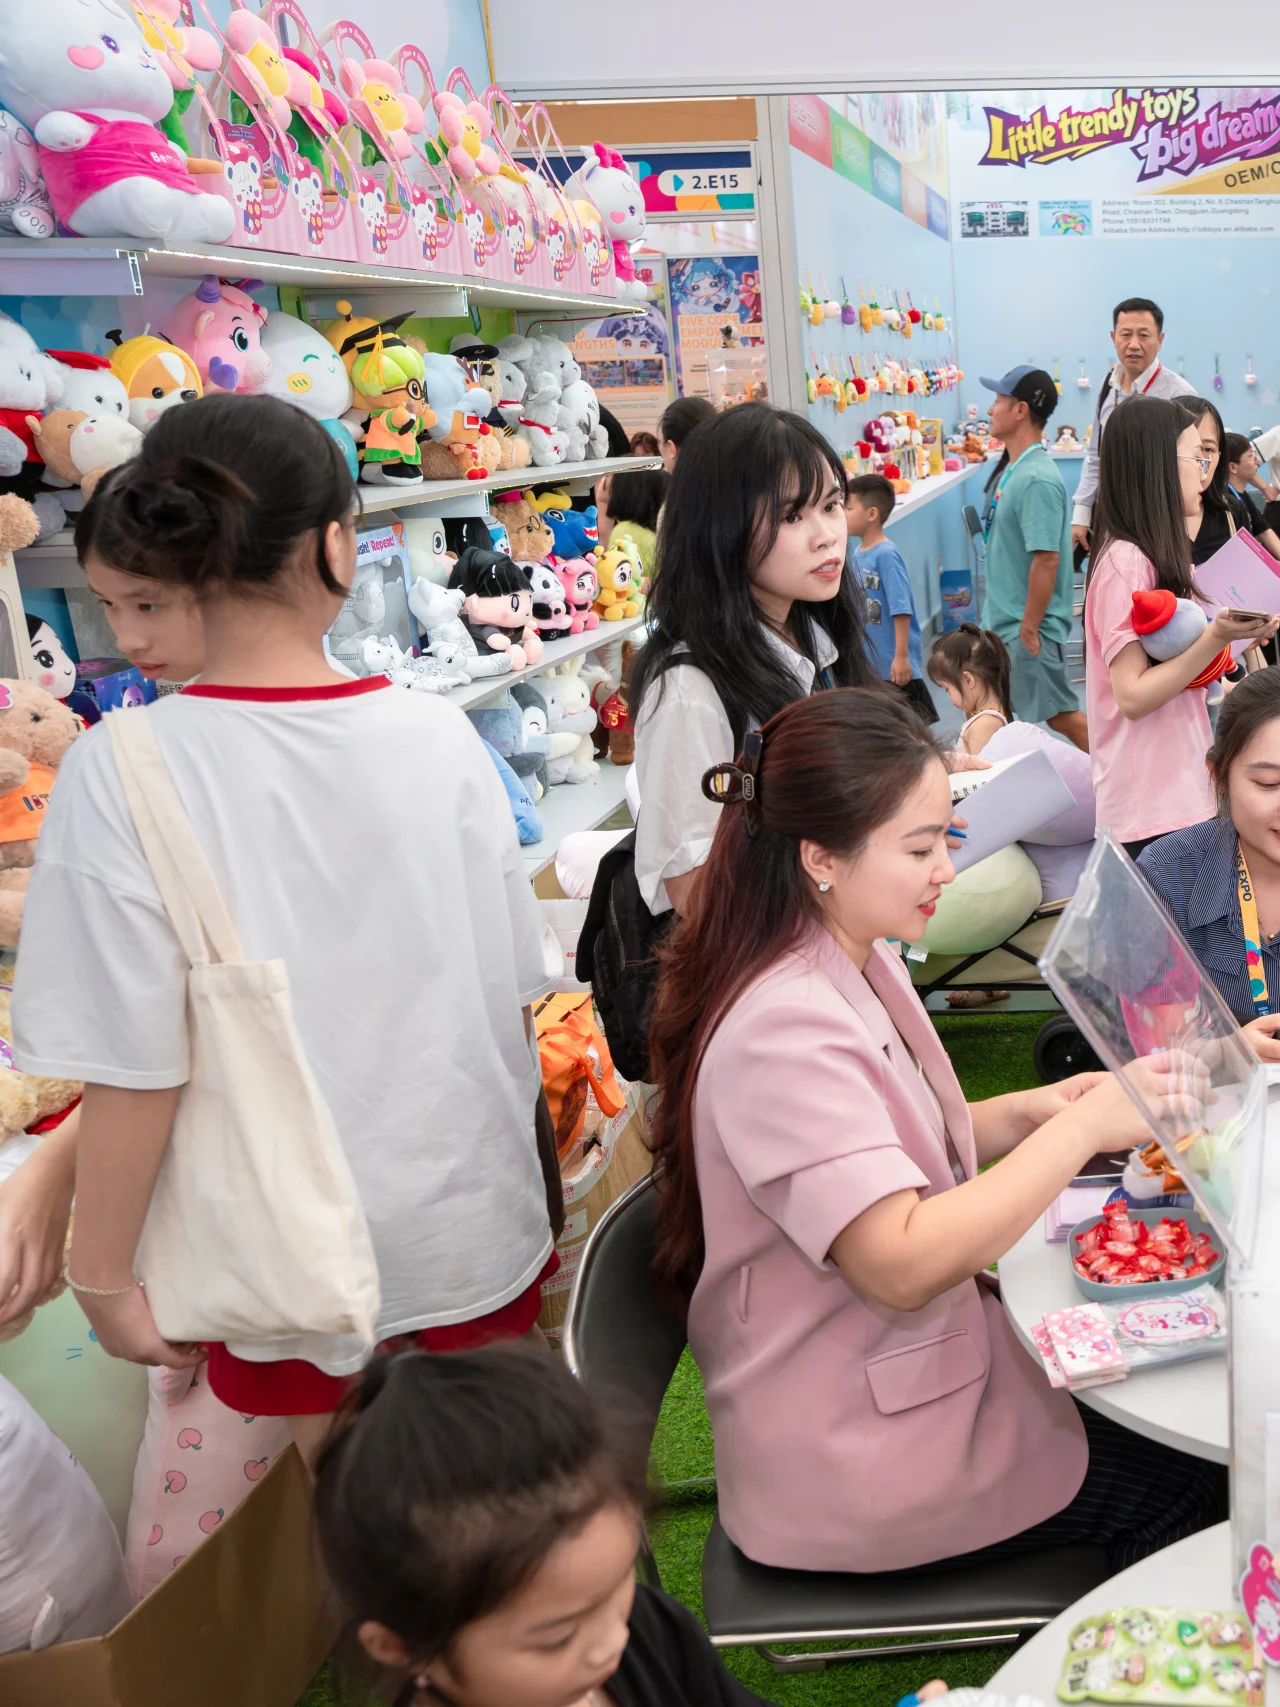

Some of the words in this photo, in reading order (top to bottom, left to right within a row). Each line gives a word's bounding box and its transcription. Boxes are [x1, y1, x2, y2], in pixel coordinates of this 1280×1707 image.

[987, 114, 1056, 162] Little
[1059, 89, 1141, 138] trendy
[1142, 88, 1197, 124] toys
[1139, 122, 1199, 175] big
[692, 175, 739, 190] 2.E15
[679, 315, 705, 326] FIVE
[370, 535, 395, 552] Repeat!
[23, 793, 50, 811] IBT
[1237, 869, 1252, 902] EXPO
